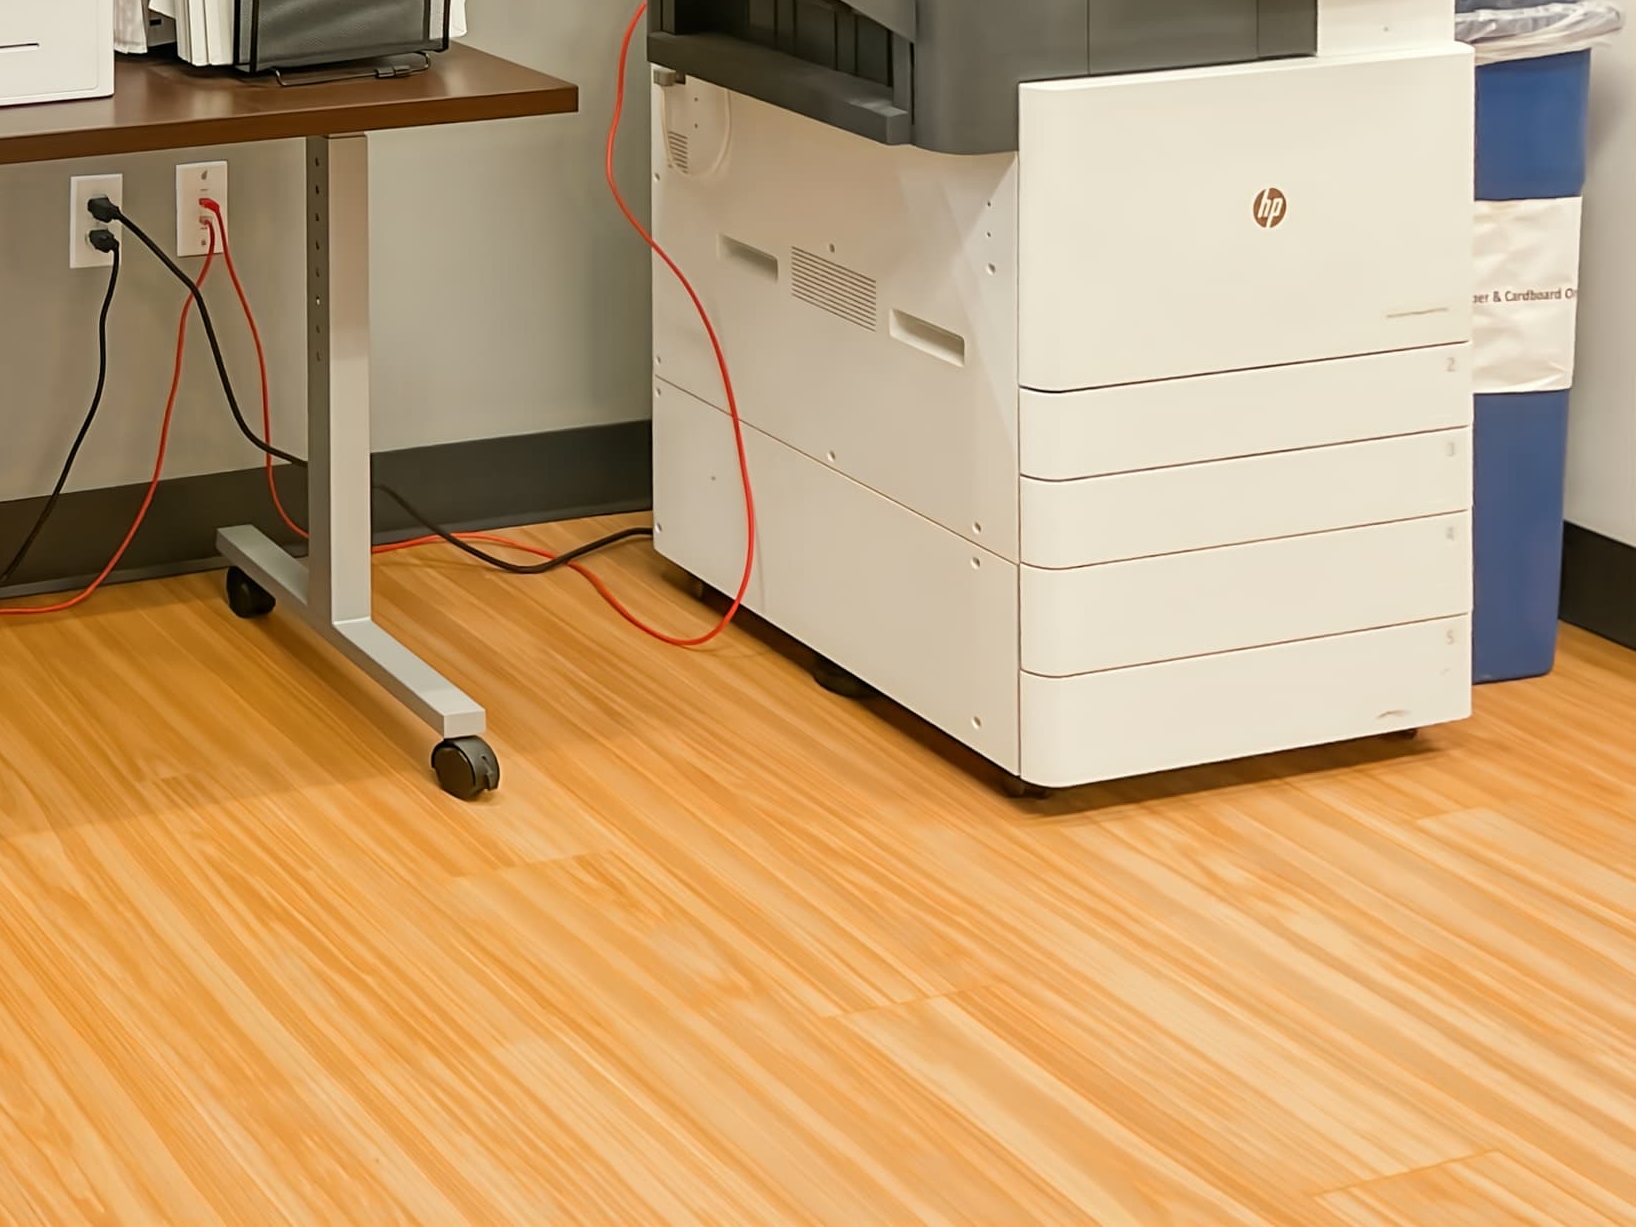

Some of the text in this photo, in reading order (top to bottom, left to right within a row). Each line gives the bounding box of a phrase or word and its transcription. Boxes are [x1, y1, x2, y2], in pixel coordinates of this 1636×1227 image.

[1254, 187, 1286, 228] hp
[1492, 290, 1502, 303] &
[1504, 287, 1562, 302] Cardboard
[1446, 356, 1456, 373] 2
